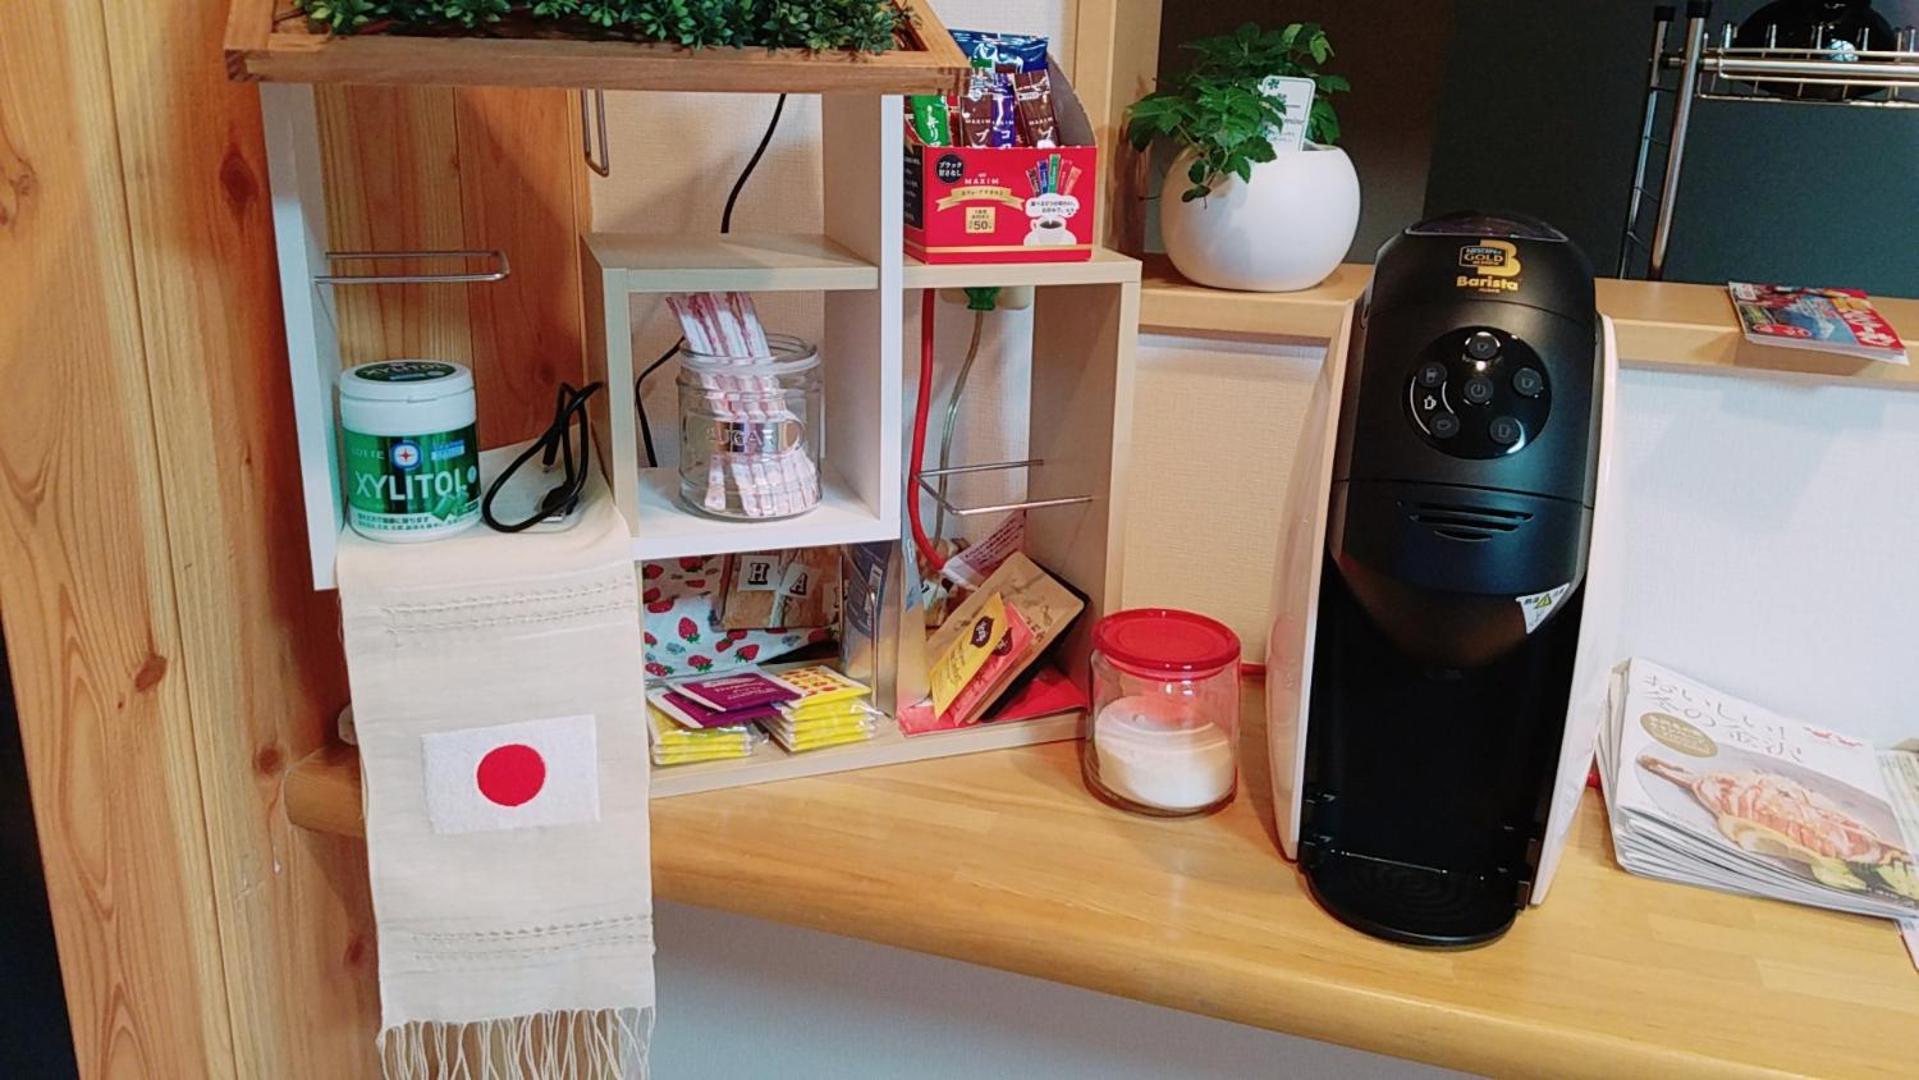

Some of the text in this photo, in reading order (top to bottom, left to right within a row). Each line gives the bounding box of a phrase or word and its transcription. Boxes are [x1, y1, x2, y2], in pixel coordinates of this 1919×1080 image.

[973, 221, 989, 231] 50
[1464, 254, 1504, 262] GOLD
[1456, 276, 1519, 291] Barista
[354, 468, 467, 501] XYLITOL
[748, 562, 770, 585] H
[789, 572, 808, 596] A
